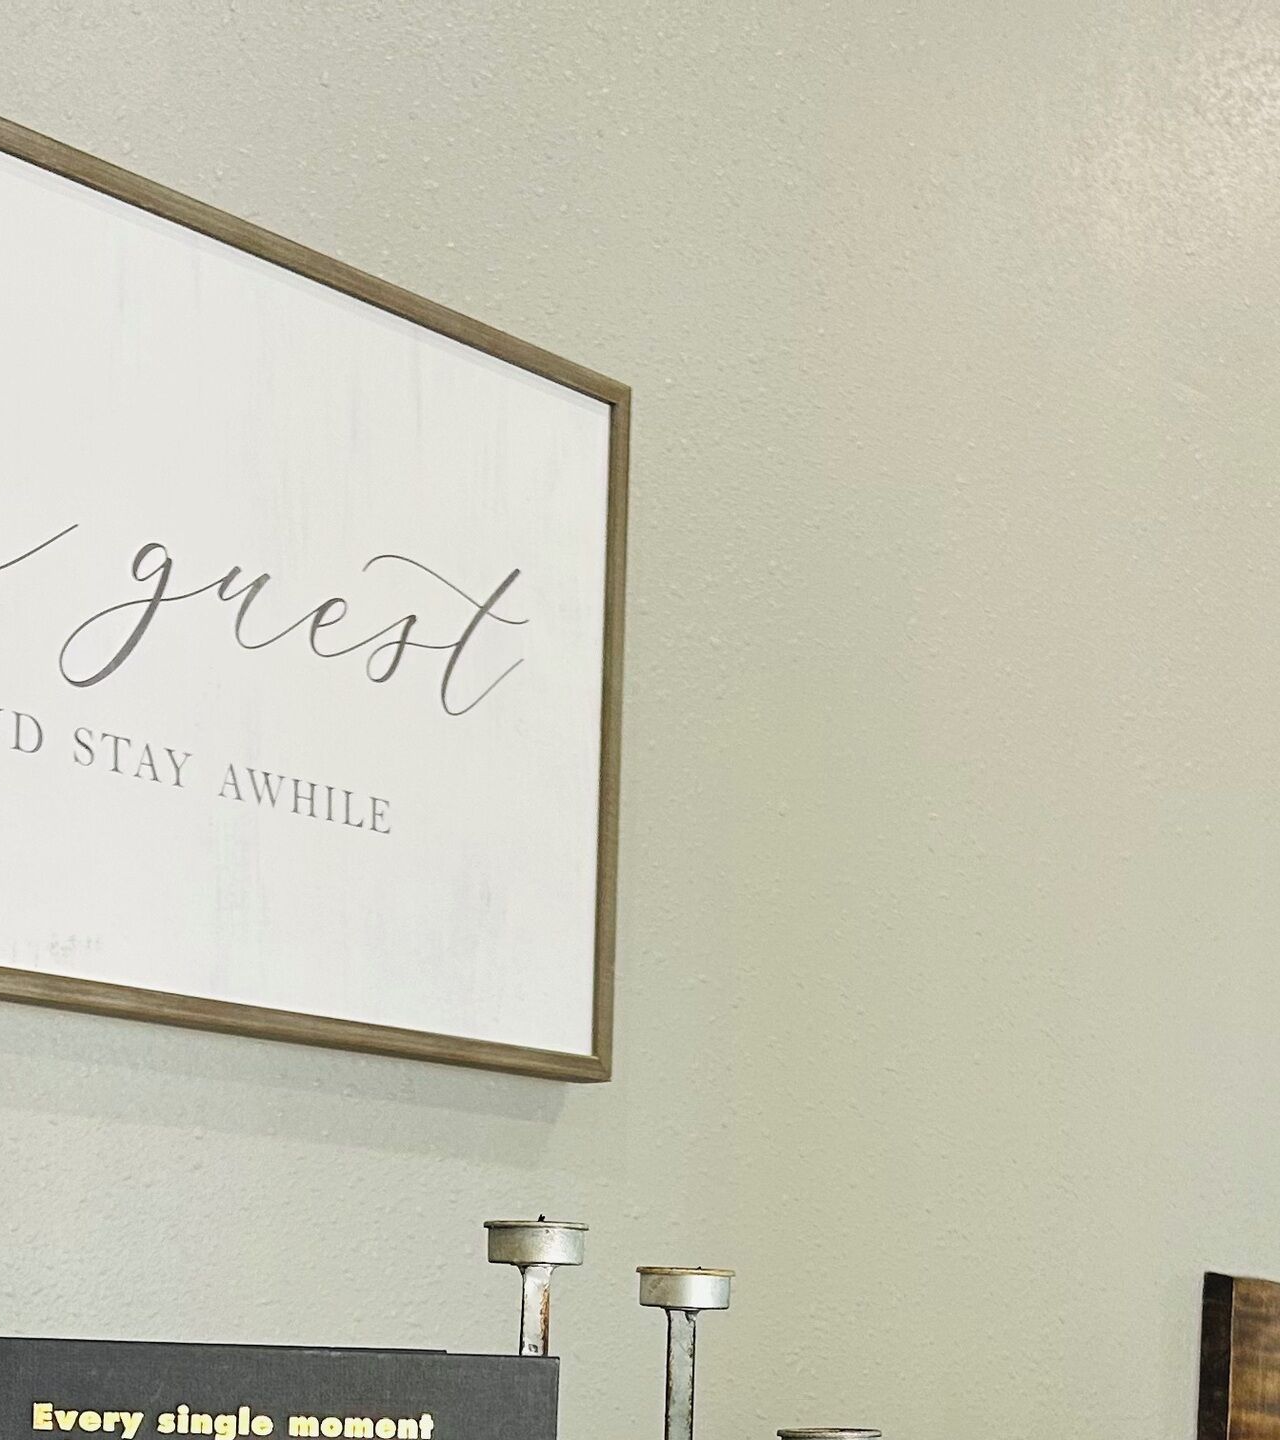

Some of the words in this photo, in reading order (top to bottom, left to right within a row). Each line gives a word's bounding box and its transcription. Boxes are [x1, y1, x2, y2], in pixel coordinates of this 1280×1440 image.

[58, 542, 531, 717] guest
[71, 726, 193, 789] STAY
[218, 762, 393, 836] AWHILE
[32, 1402, 145, 1440] Every
[288, 1413, 435, 1440] moment
